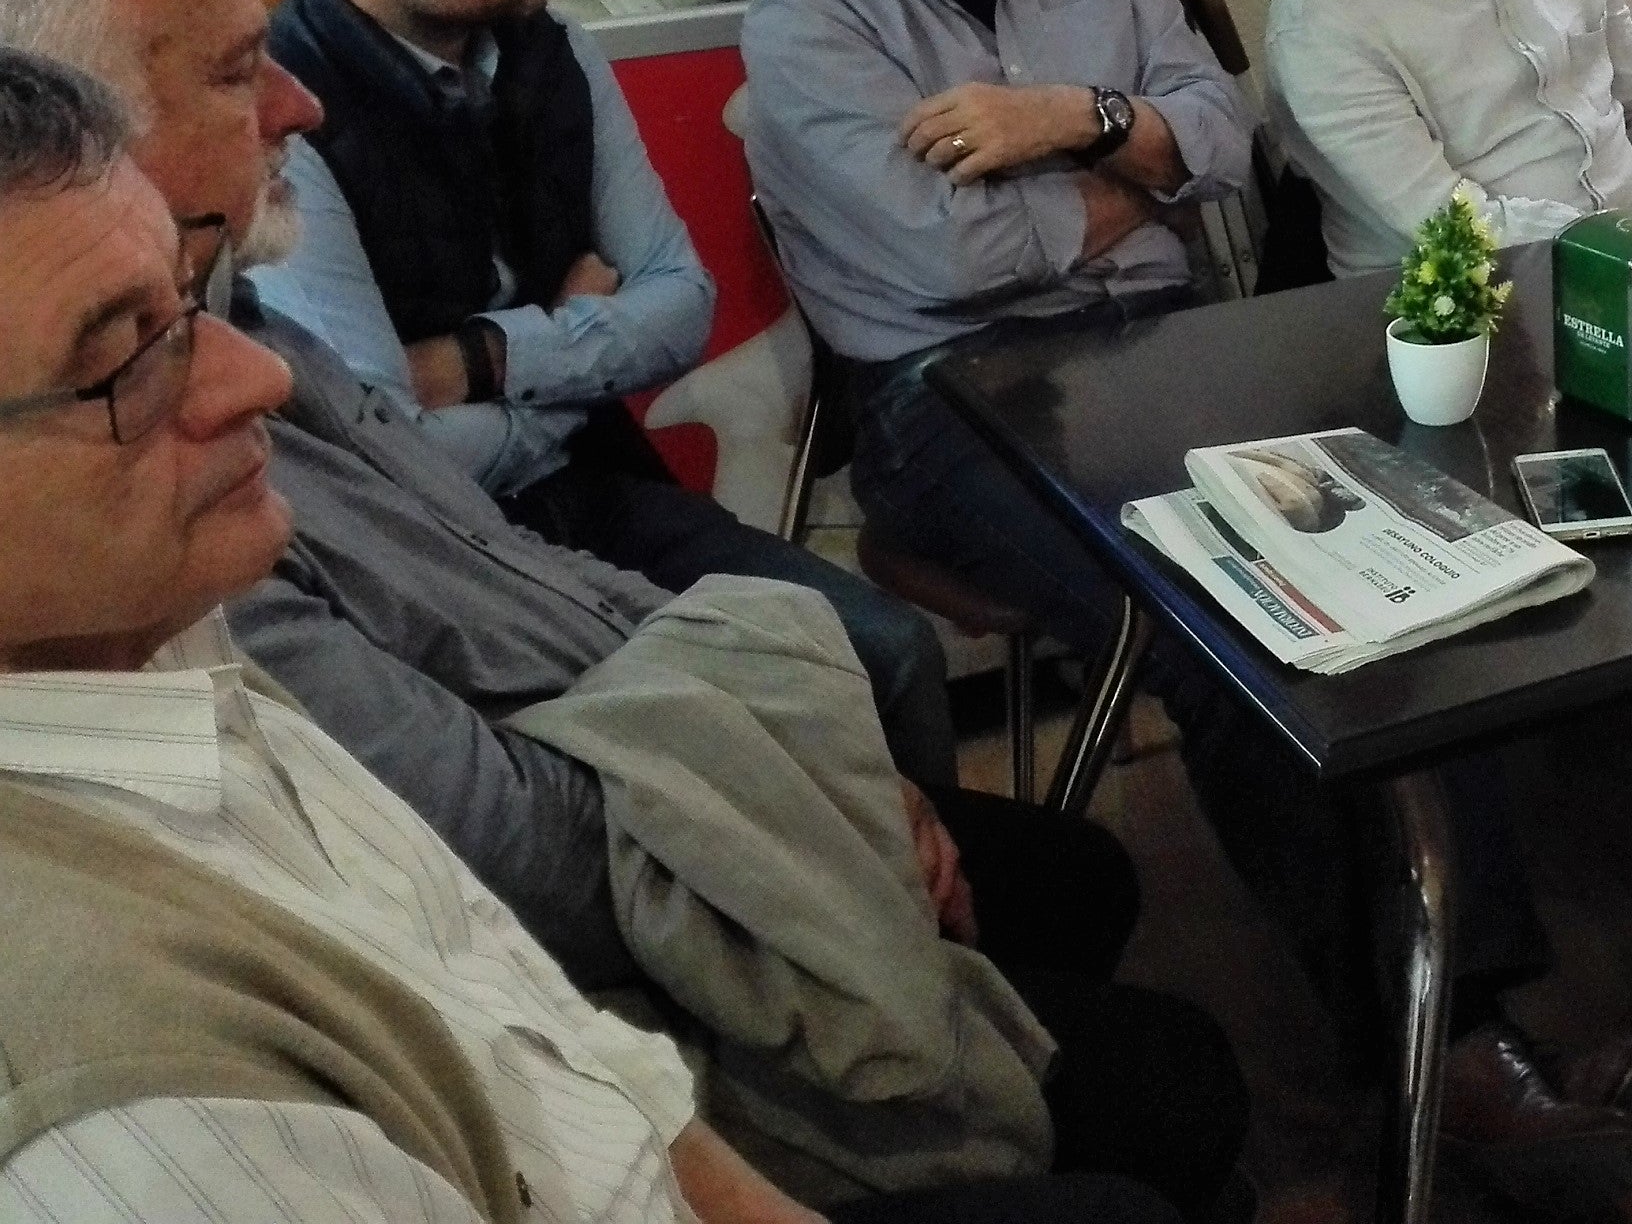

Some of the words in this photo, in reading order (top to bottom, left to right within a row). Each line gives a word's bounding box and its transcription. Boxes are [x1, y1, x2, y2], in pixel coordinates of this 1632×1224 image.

[1563, 313, 1624, 348] ESTRELLA
[1382, 528, 1423, 553] DESAYUNO
[1420, 552, 1460, 579] COLOQUIO
